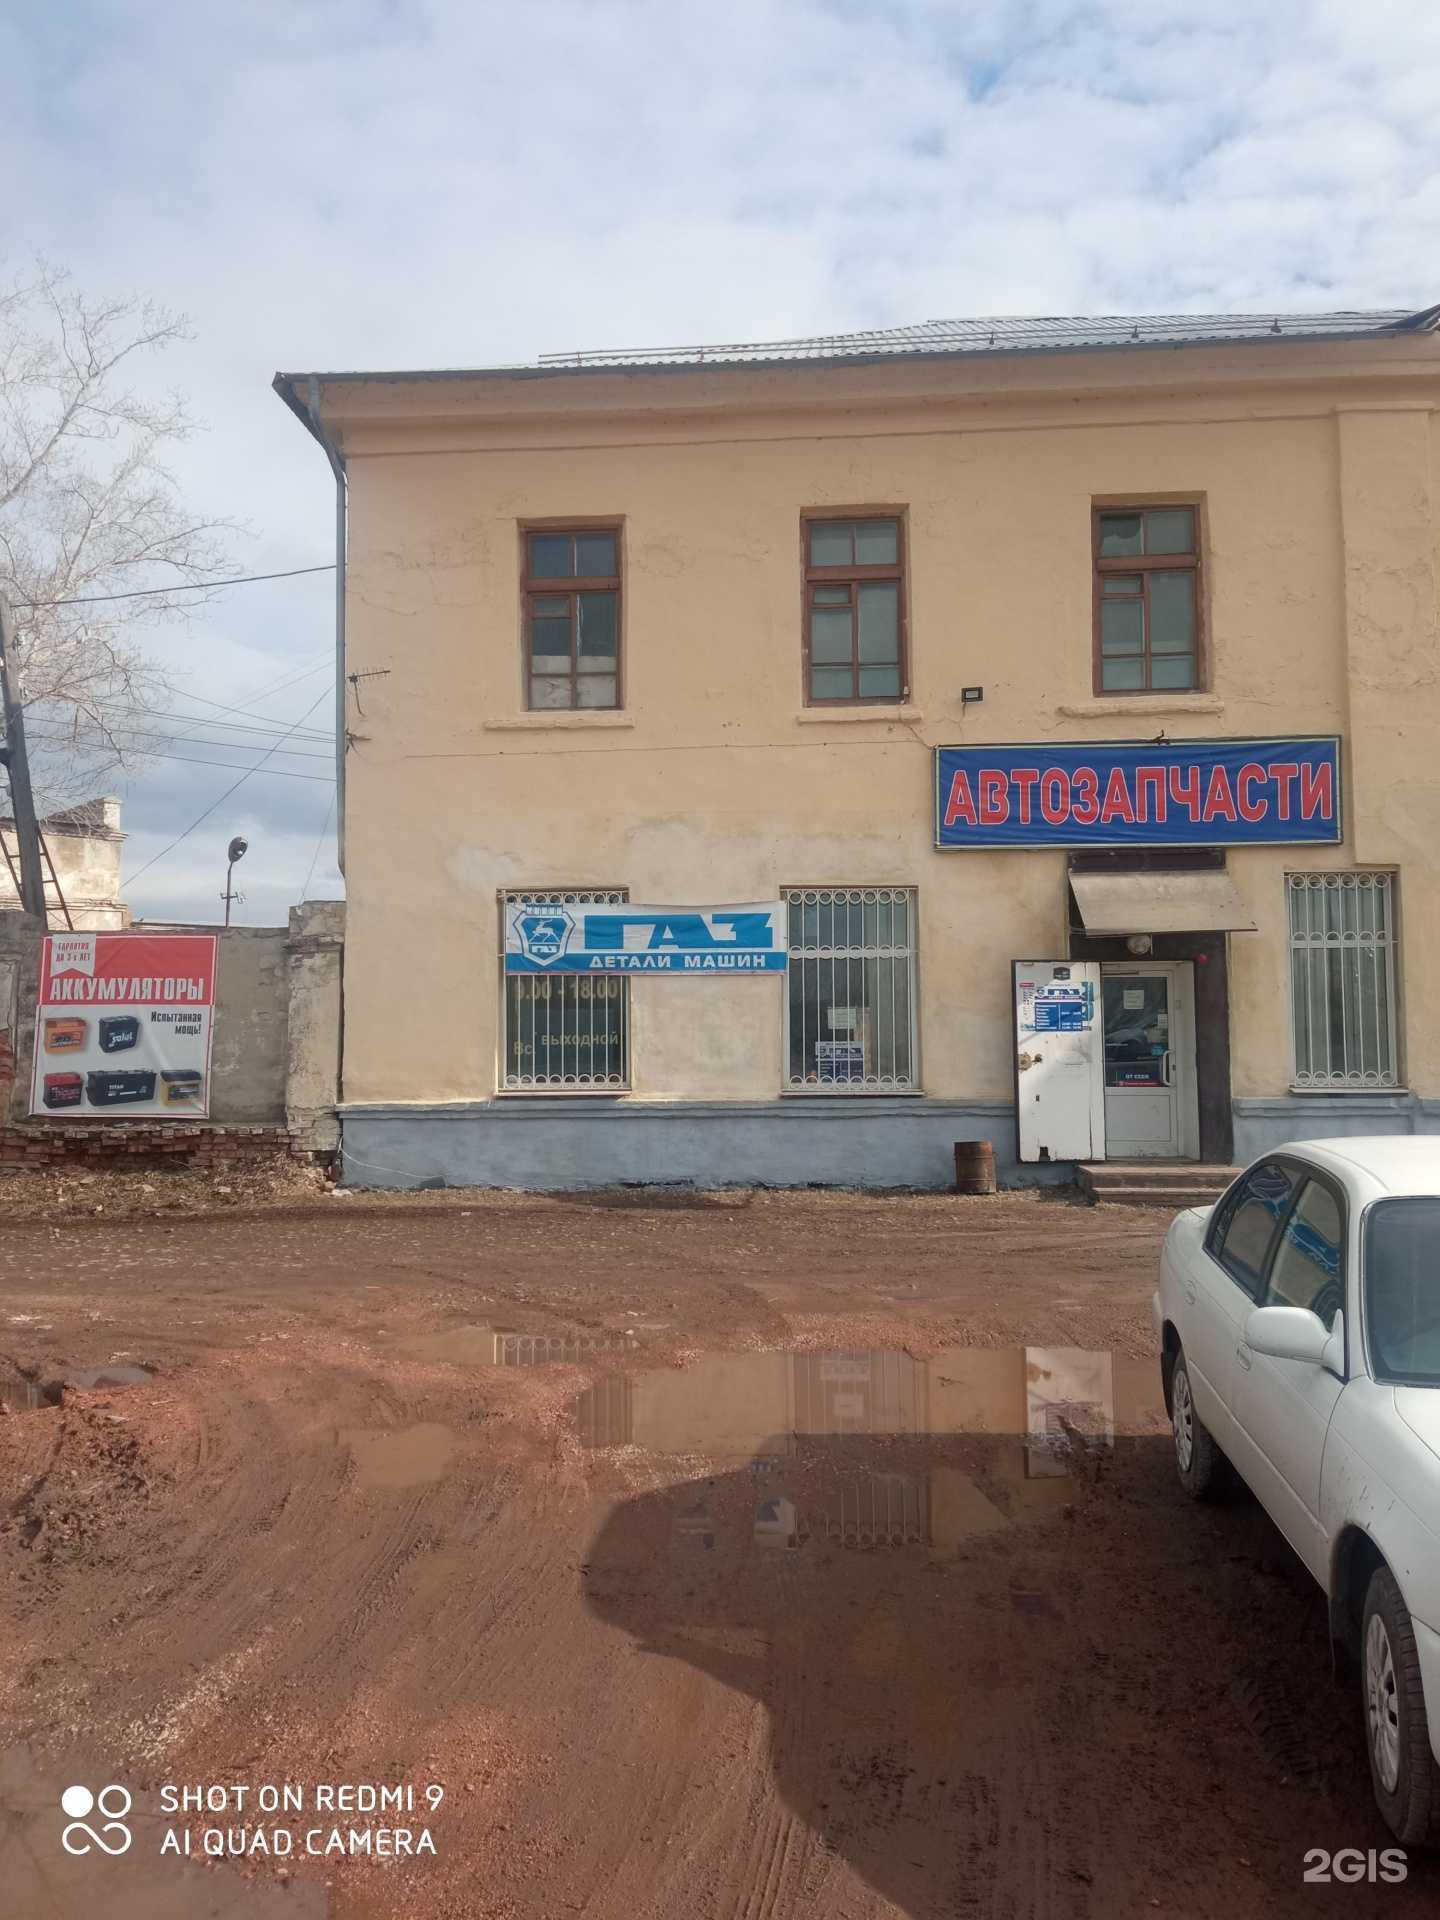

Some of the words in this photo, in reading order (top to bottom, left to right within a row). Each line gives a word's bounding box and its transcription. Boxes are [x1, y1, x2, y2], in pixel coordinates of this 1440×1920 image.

[944, 762, 1332, 826] АВТОЗАПЧАСТИ
[584, 912, 774, 949] ГАЗ
[589, 955, 672, 969] ДЕТАЛИ
[684, 954, 767, 968] МАШИН
[50, 977, 204, 1001] АККУМУЛЯТОРЫ
[151, 1011, 202, 1023] Испытанная
[175, 1024, 201, 1035] мощь!
[541, 1031, 619, 1047] выходной
